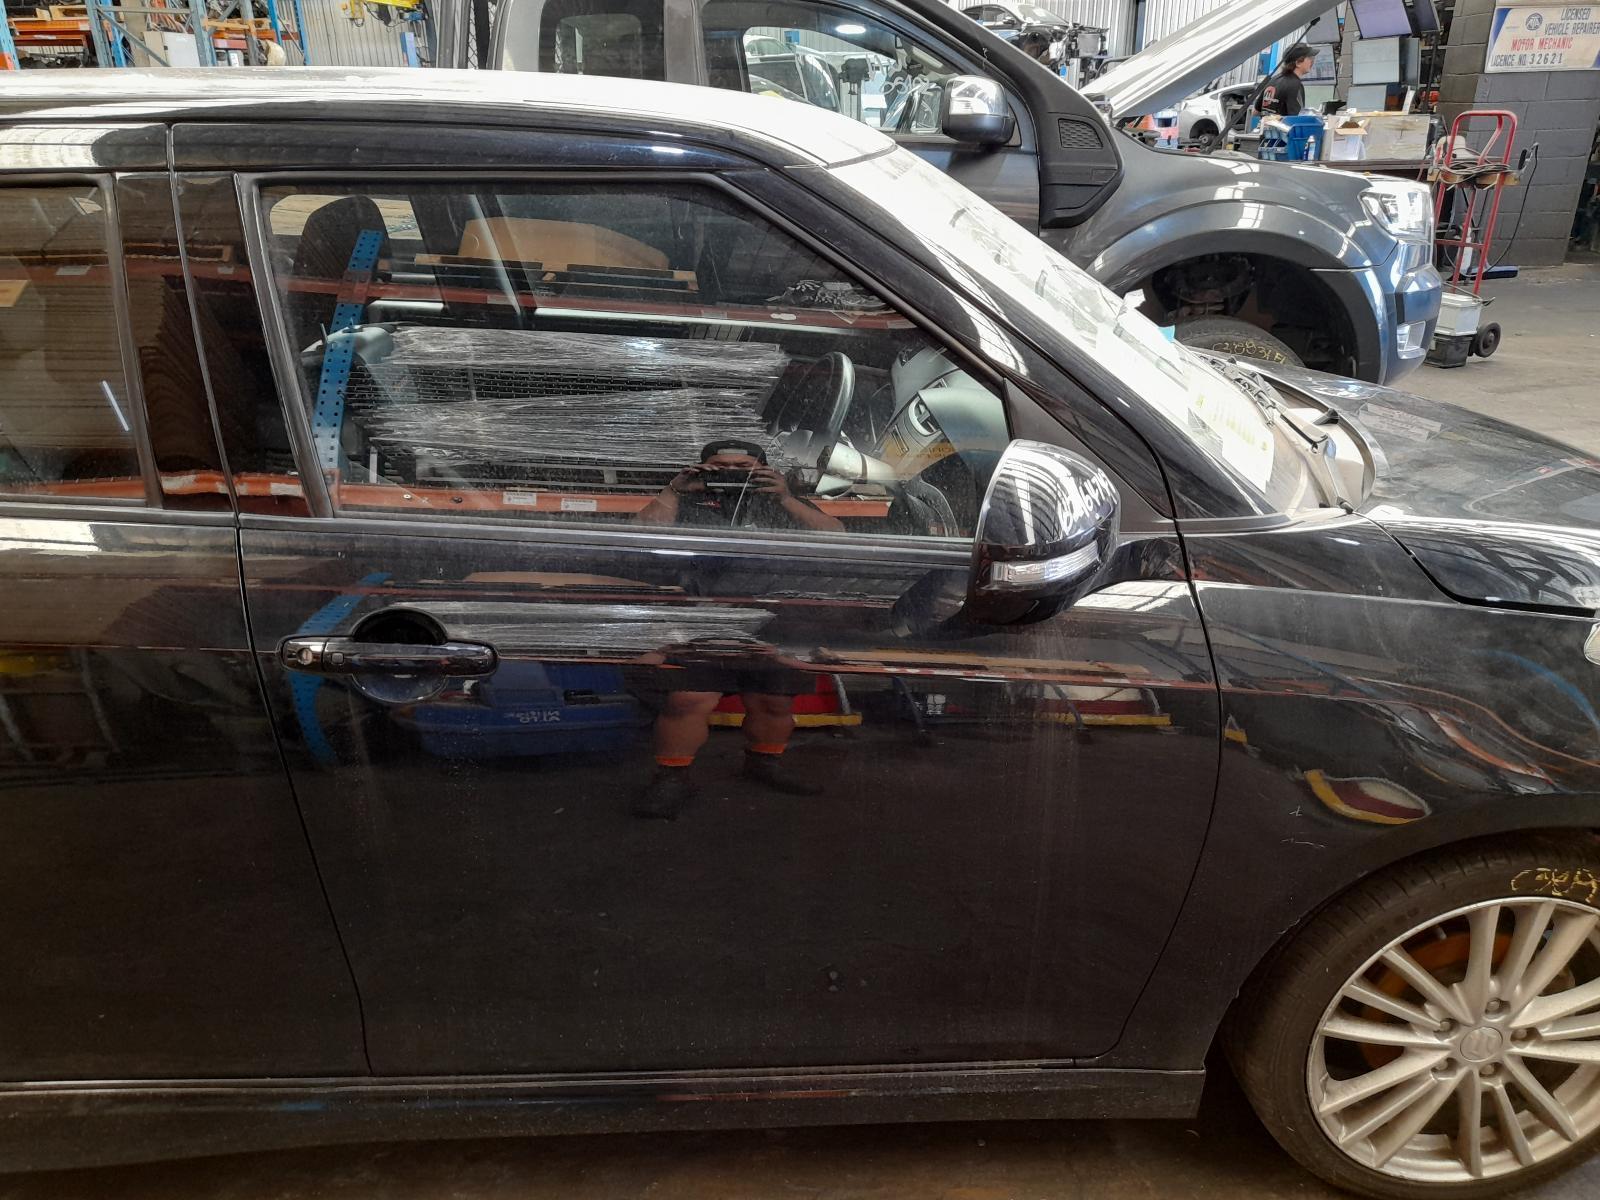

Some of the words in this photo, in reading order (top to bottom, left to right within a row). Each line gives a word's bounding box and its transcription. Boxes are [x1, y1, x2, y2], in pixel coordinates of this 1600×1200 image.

[1560, 8, 1591, 20] LICENSED
[1544, 23, 1571, 35] VEHICLE
[1511, 38, 1534, 51] MOTOR
[1538, 37, 1573, 50] MECHANIC
[1490, 54, 1516, 67] LICENCE
[1529, 53, 1563, 65] 32621
